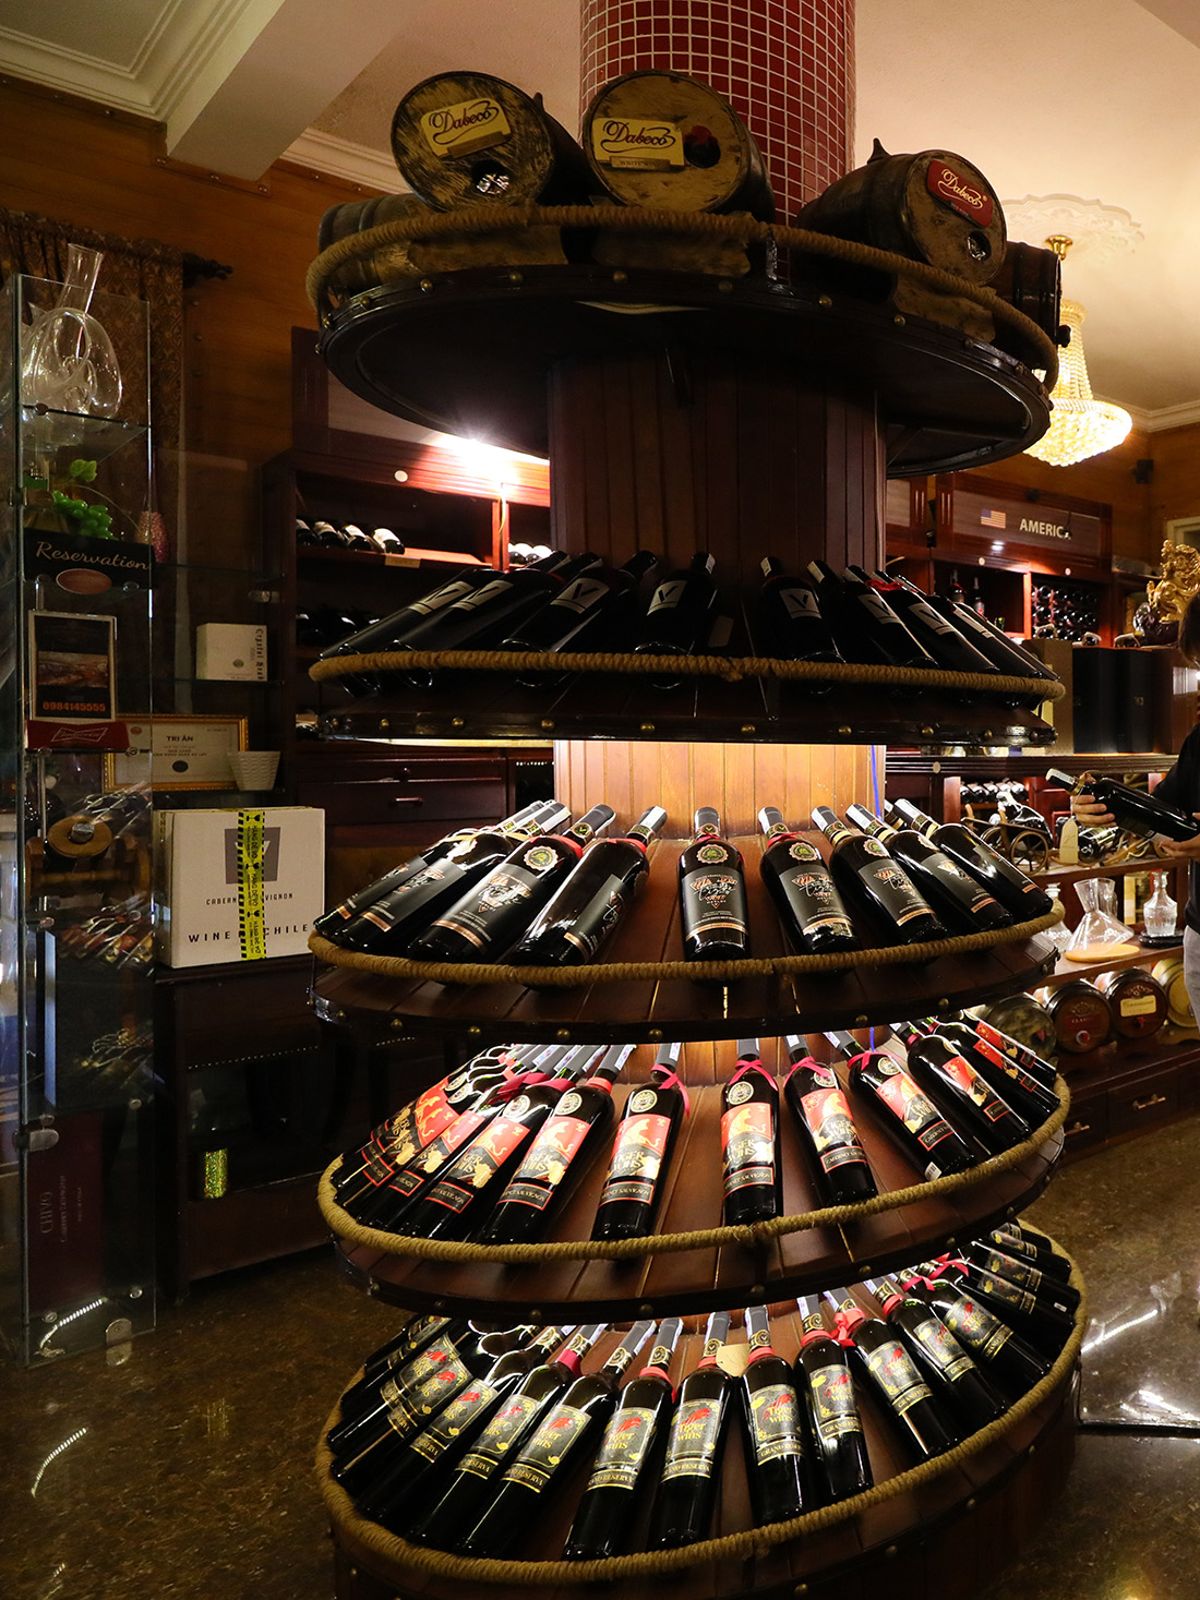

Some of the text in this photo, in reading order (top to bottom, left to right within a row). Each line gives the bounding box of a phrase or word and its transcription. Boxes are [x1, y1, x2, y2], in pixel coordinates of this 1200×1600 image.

[428, 100, 499, 140] Dabeco
[601, 120, 676, 150] Dabeco
[938, 168, 983, 209] Dabeco
[1020, 518, 1070, 540] AMERIC
[36, 541, 150, 571] Reservation
[206, 898, 238, 906] CABERN
[188, 923, 309, 943] WINE CHILE
